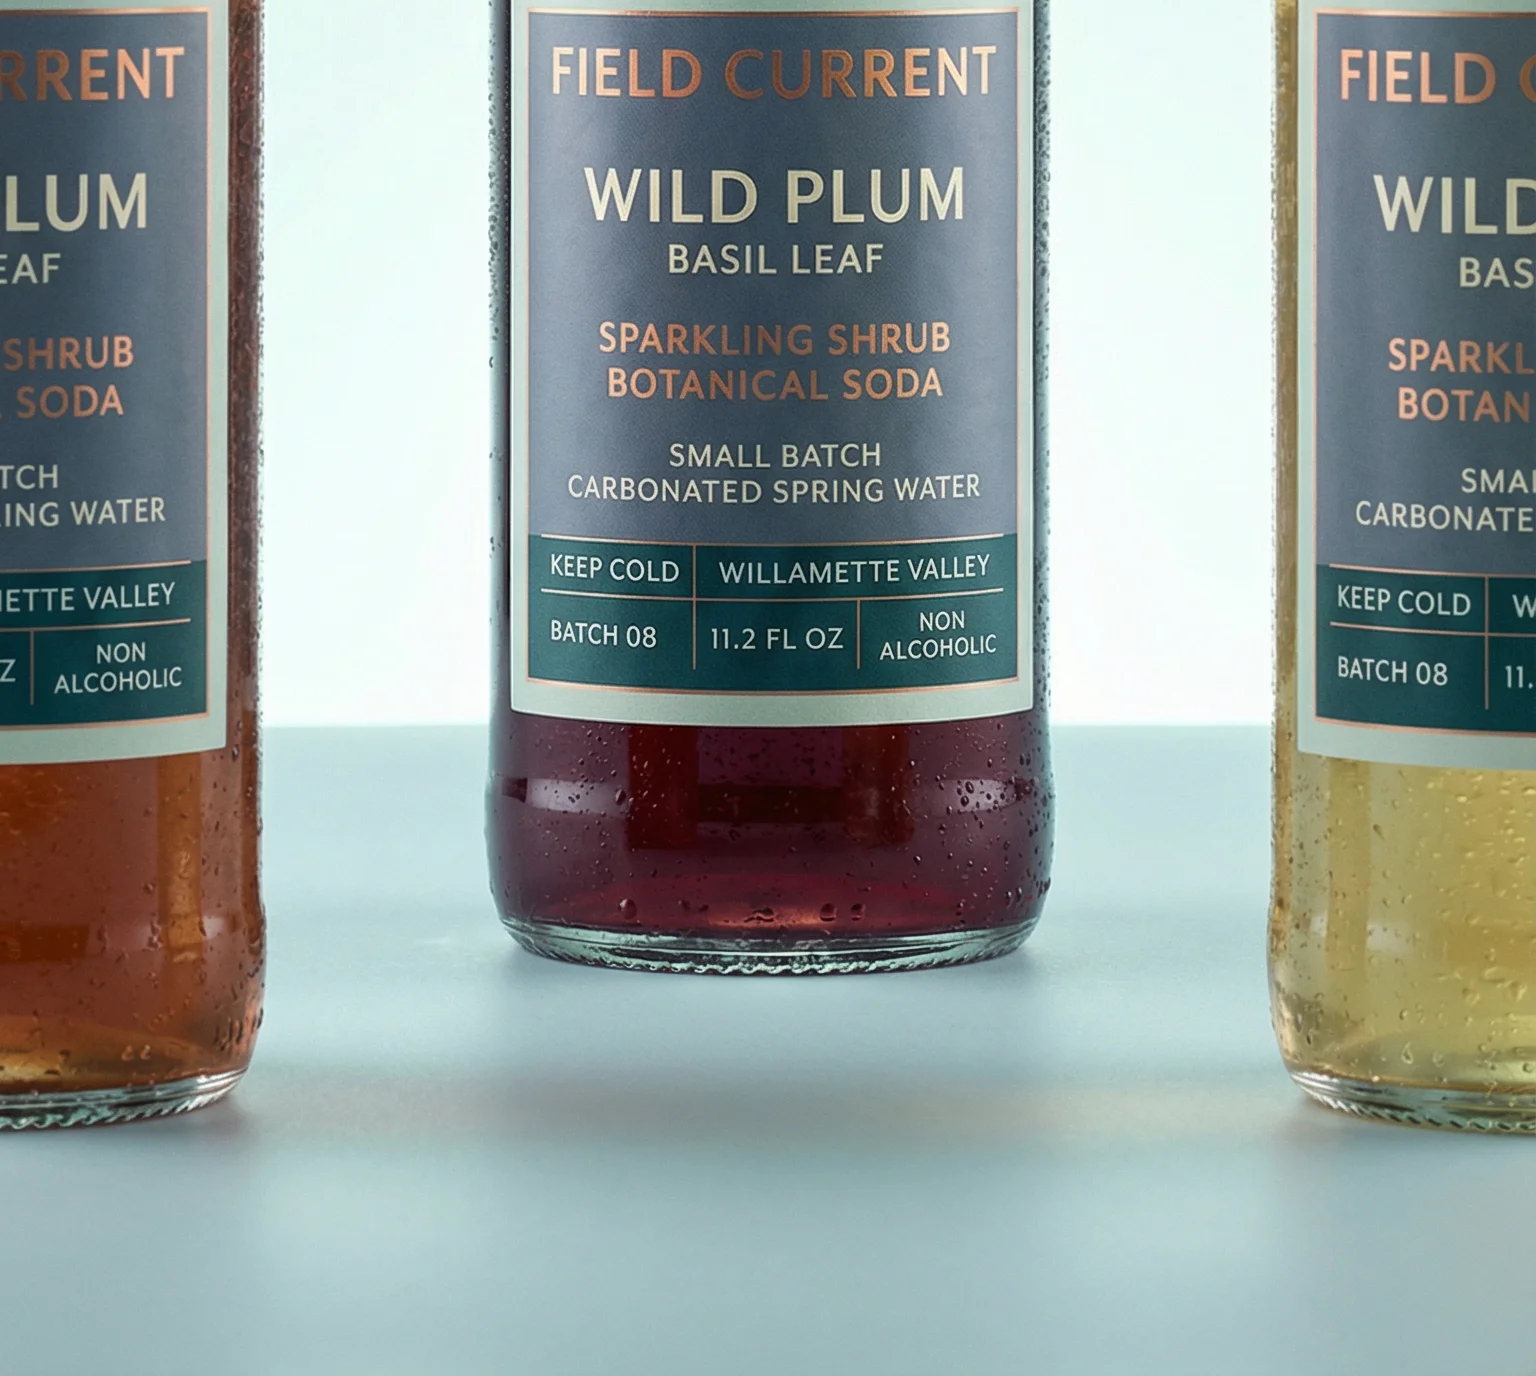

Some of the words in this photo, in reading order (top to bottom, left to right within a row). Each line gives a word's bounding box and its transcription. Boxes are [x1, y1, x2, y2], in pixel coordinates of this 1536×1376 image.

[552, 46, 702, 98] FIELD
[724, 45, 997, 99] CURRENT
[1340, 48, 1496, 104] FIELD
[5, 172, 147, 232] LUM
[583, 167, 758, 224] WILD
[787, 166, 963, 224] PLUM
[1373, 174, 1536, 235] WILD
[668, 243, 777, 275] BASIL
[792, 243, 884, 274] LEAF
[1459, 256, 1535, 289] BAS
[5, 335, 134, 370] SHRUB
[599, 321, 813, 355] SPARKLING
[829, 321, 951, 355] SHRUB
[1388, 337, 1536, 374] SPARKL
[608, 367, 829, 401] BOTANICAL
[843, 367, 943, 400] SODA
[17, 384, 124, 418] SODA
[1398, 386, 1529, 422] BOTAN
[669, 443, 771, 468] SMALL
[781, 442, 881, 468] BATCH
[568, 474, 762, 504] CARBONATED
[773, 478, 884, 504] SPRING
[893, 473, 980, 501] WATER
[1461, 467, 1536, 494] SMA
[0, 501, 60, 528] ING
[70, 496, 166, 526] WATER
[1355, 500, 1534, 532] CARBONATE
[551, 553, 603, 579] KEEP
[609, 558, 680, 583] COLD
[718, 559, 900, 584] WILLAMETTE
[907, 553, 990, 581] VALLEY
[0, 587, 75, 613] ETTE
[82, 581, 176, 610] VALLEY
[1337, 584, 1391, 612] KEEP
[1397, 589, 1472, 616] COLD
[551, 619, 618, 646] BATCH
[626, 625, 657, 649] 08
[919, 610, 965, 632] NON
[96, 641, 146, 664] NON
[711, 627, 756, 650] 11.2
[767, 628, 797, 650] FL
[805, 627, 844, 650] OZ
[879, 633, 997, 661] ALCOHOLIC
[53, 666, 182, 694] ALCOHOLIC
[1338, 655, 1408, 684] BATCH
[1415, 661, 1448, 686] 08
